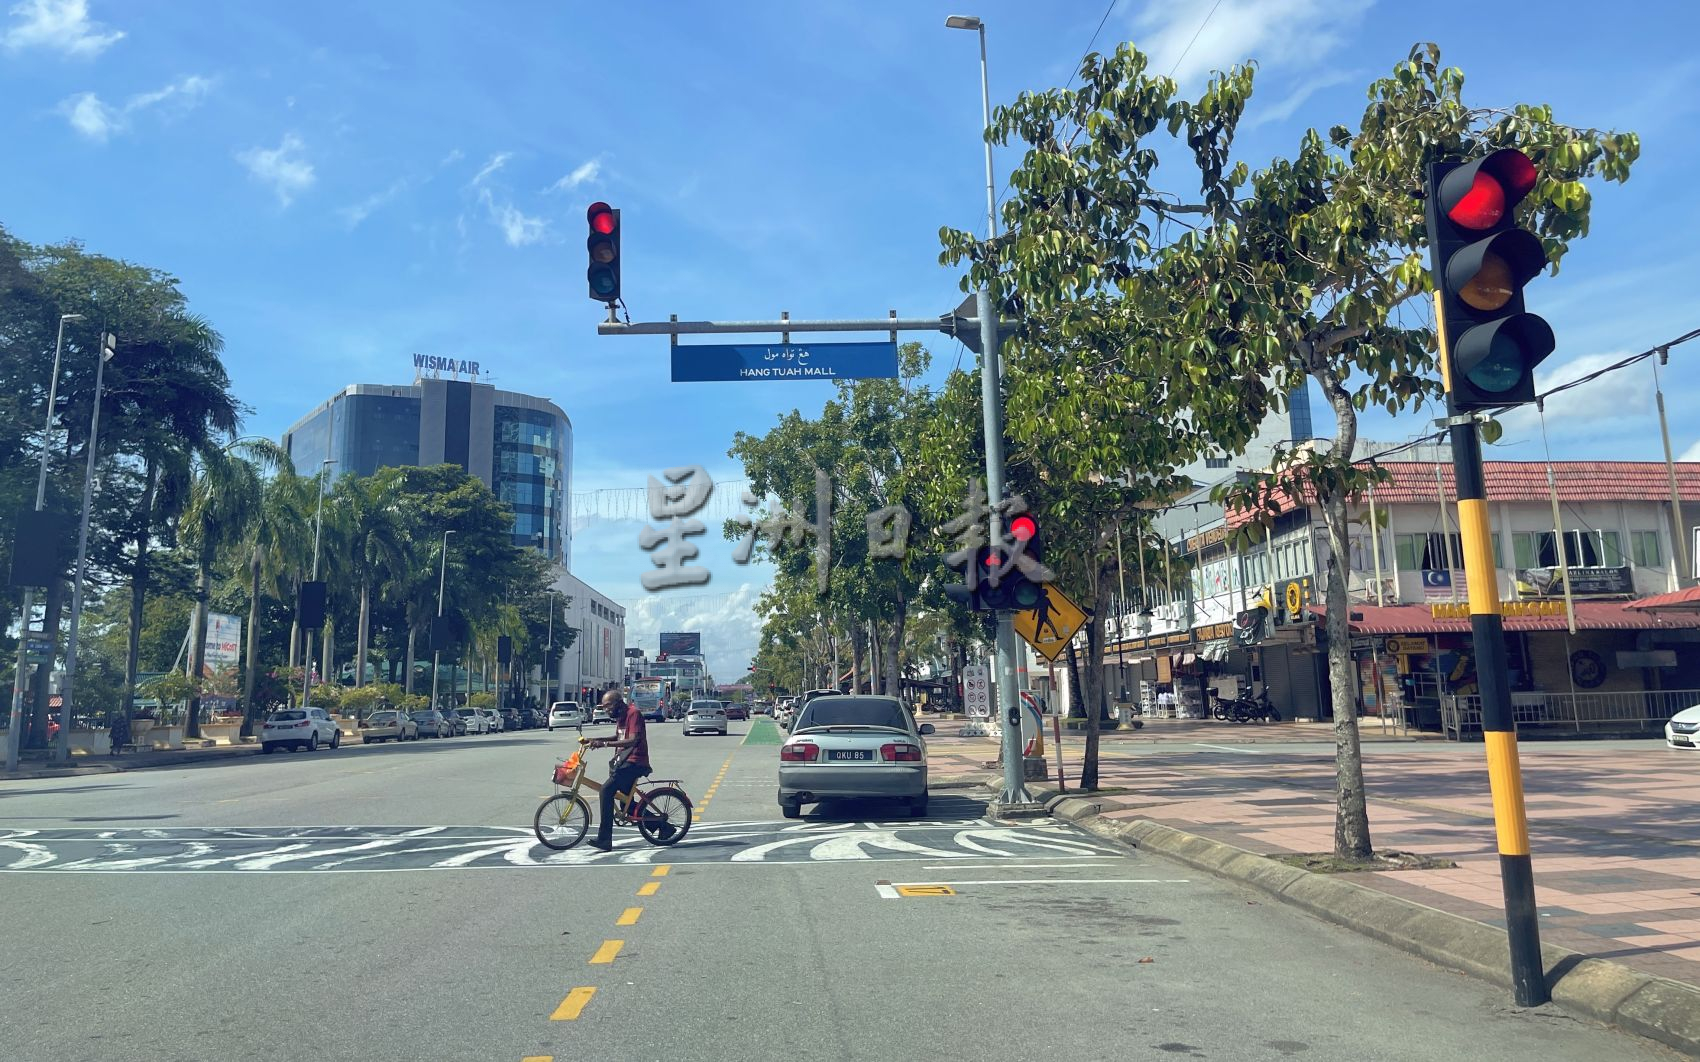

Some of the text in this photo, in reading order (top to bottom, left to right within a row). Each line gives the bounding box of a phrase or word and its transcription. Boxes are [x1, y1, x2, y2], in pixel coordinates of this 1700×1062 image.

[413, 353, 480, 375] WISMA AIR
[740, 367, 836, 377] HANG TUAH MALL
[836, 751, 865, 760] QKU 85
